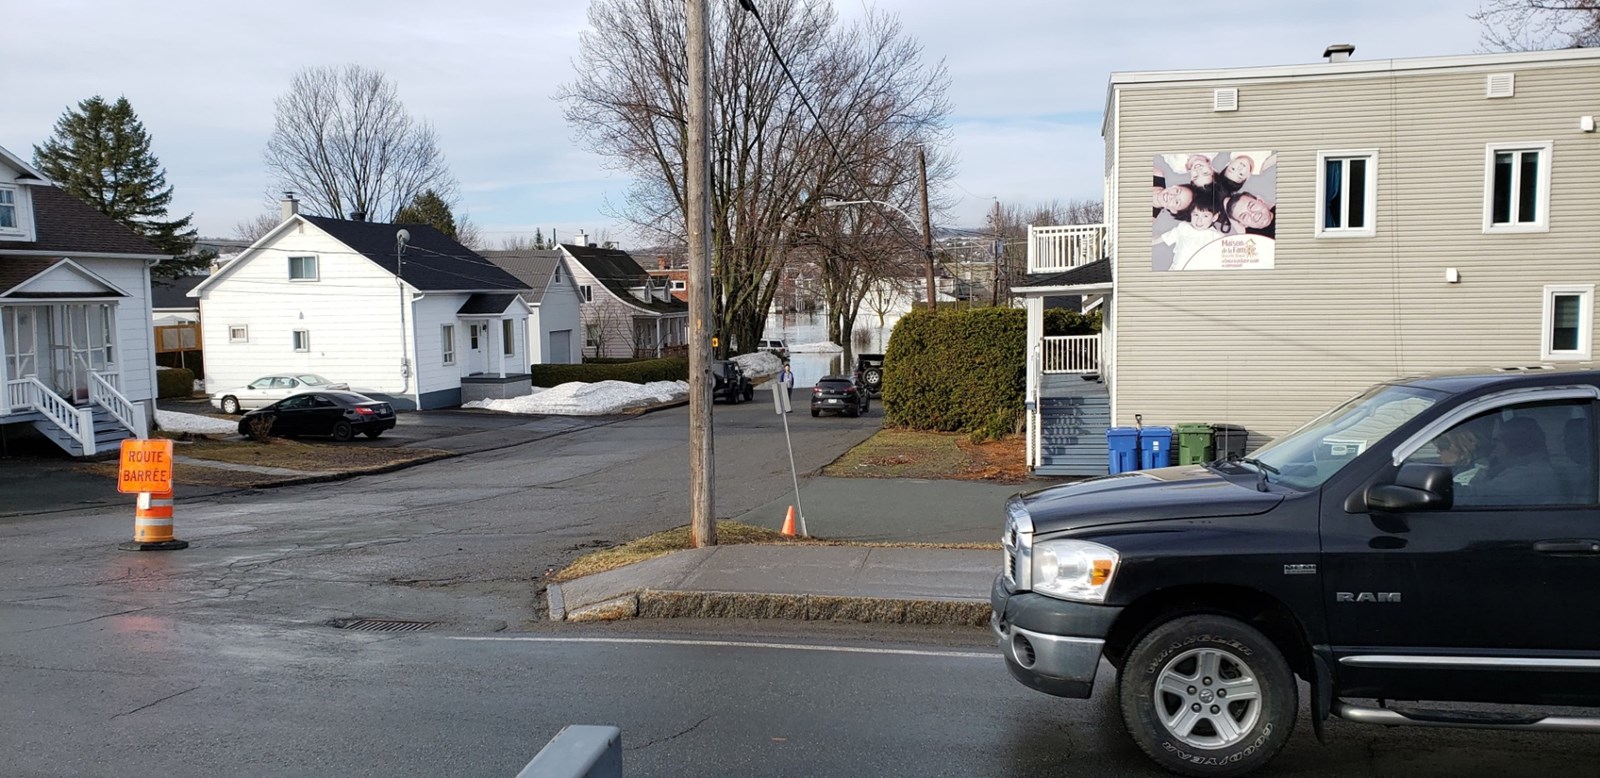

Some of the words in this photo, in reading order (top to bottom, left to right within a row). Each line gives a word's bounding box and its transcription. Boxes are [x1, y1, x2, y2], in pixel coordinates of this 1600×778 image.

[1221, 239, 1244, 247] Maison
[128, 450, 164, 463] ROUTE
[123, 467, 167, 482] BARRÉE
[1336, 591, 1402, 603] RAM
[1146, 634, 1254, 675] WRANGLER
[1162, 722, 1274, 766] GOODYEAR
